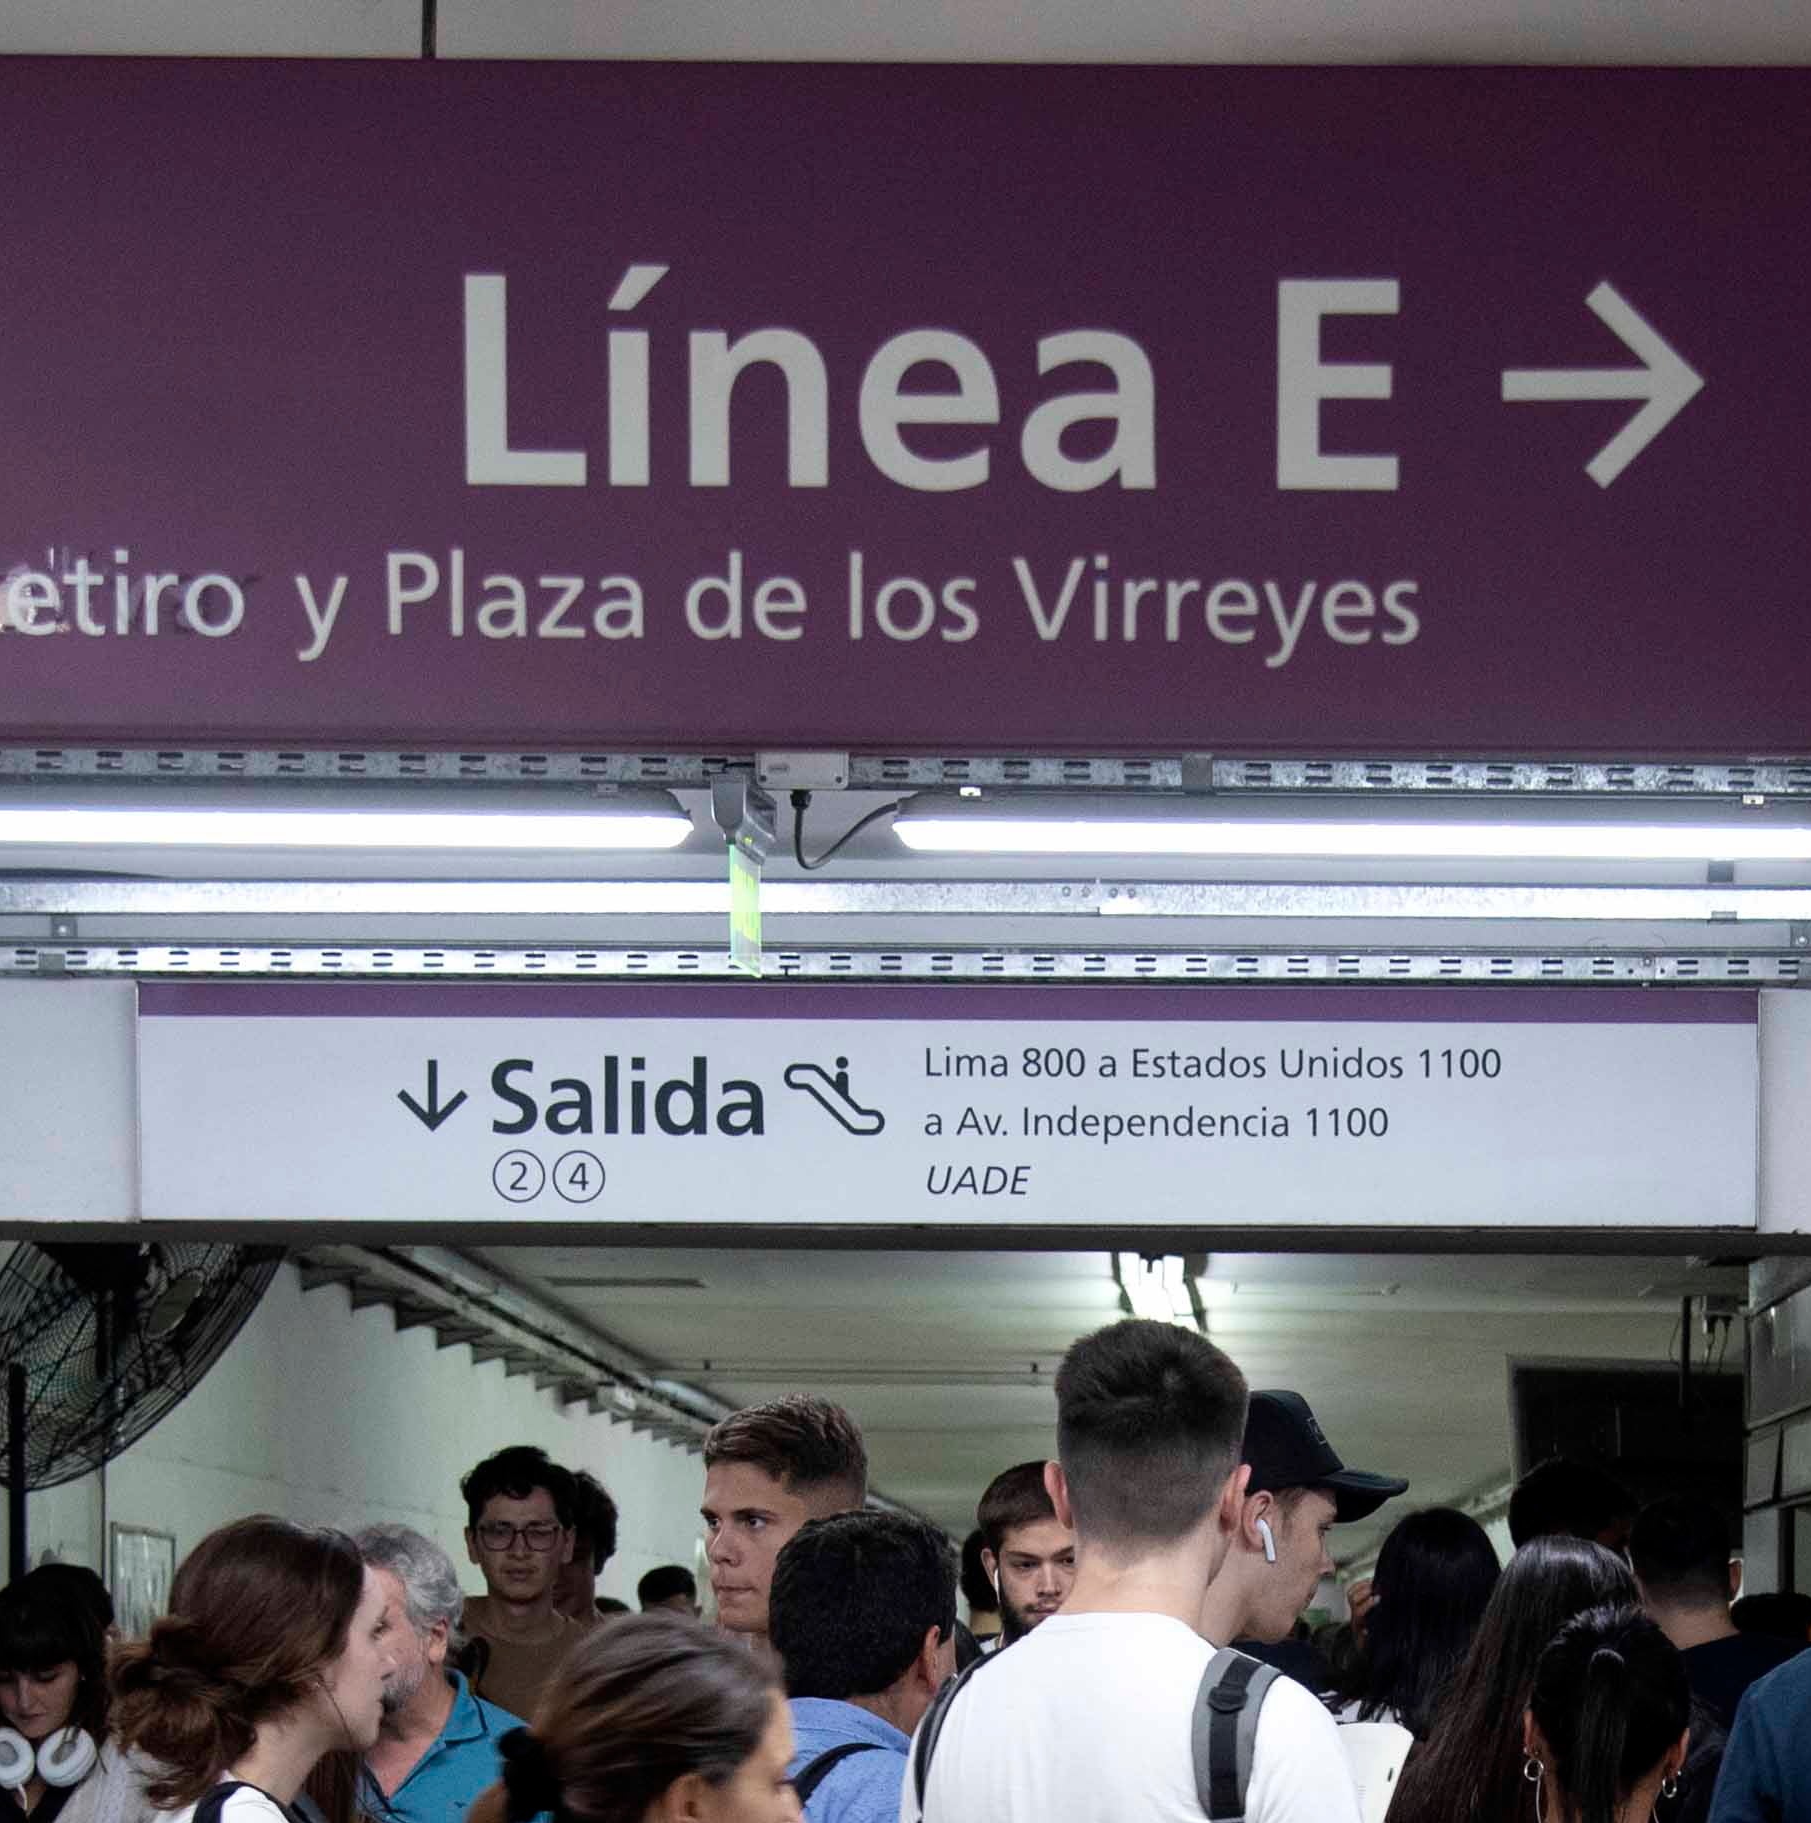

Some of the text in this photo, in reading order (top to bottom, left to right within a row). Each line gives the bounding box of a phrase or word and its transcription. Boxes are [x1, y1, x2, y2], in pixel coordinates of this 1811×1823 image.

[463, 263, 1401, 492] Línea E
[295, 575, 349, 663] y
[386, 548, 644, 641] Plaza
[685, 550, 807, 641] de
[849, 550, 980, 642] los
[1012, 557, 1420, 668] Virreyes
[925, 1046, 1502, 1079] Lima 800 a Estados Unidos 1100
[489, 1054, 766, 1138] Salida
[924, 1104, 1389, 1145] a Av. Independencia 1100
[926, 1165, 1031, 1196] UADE
